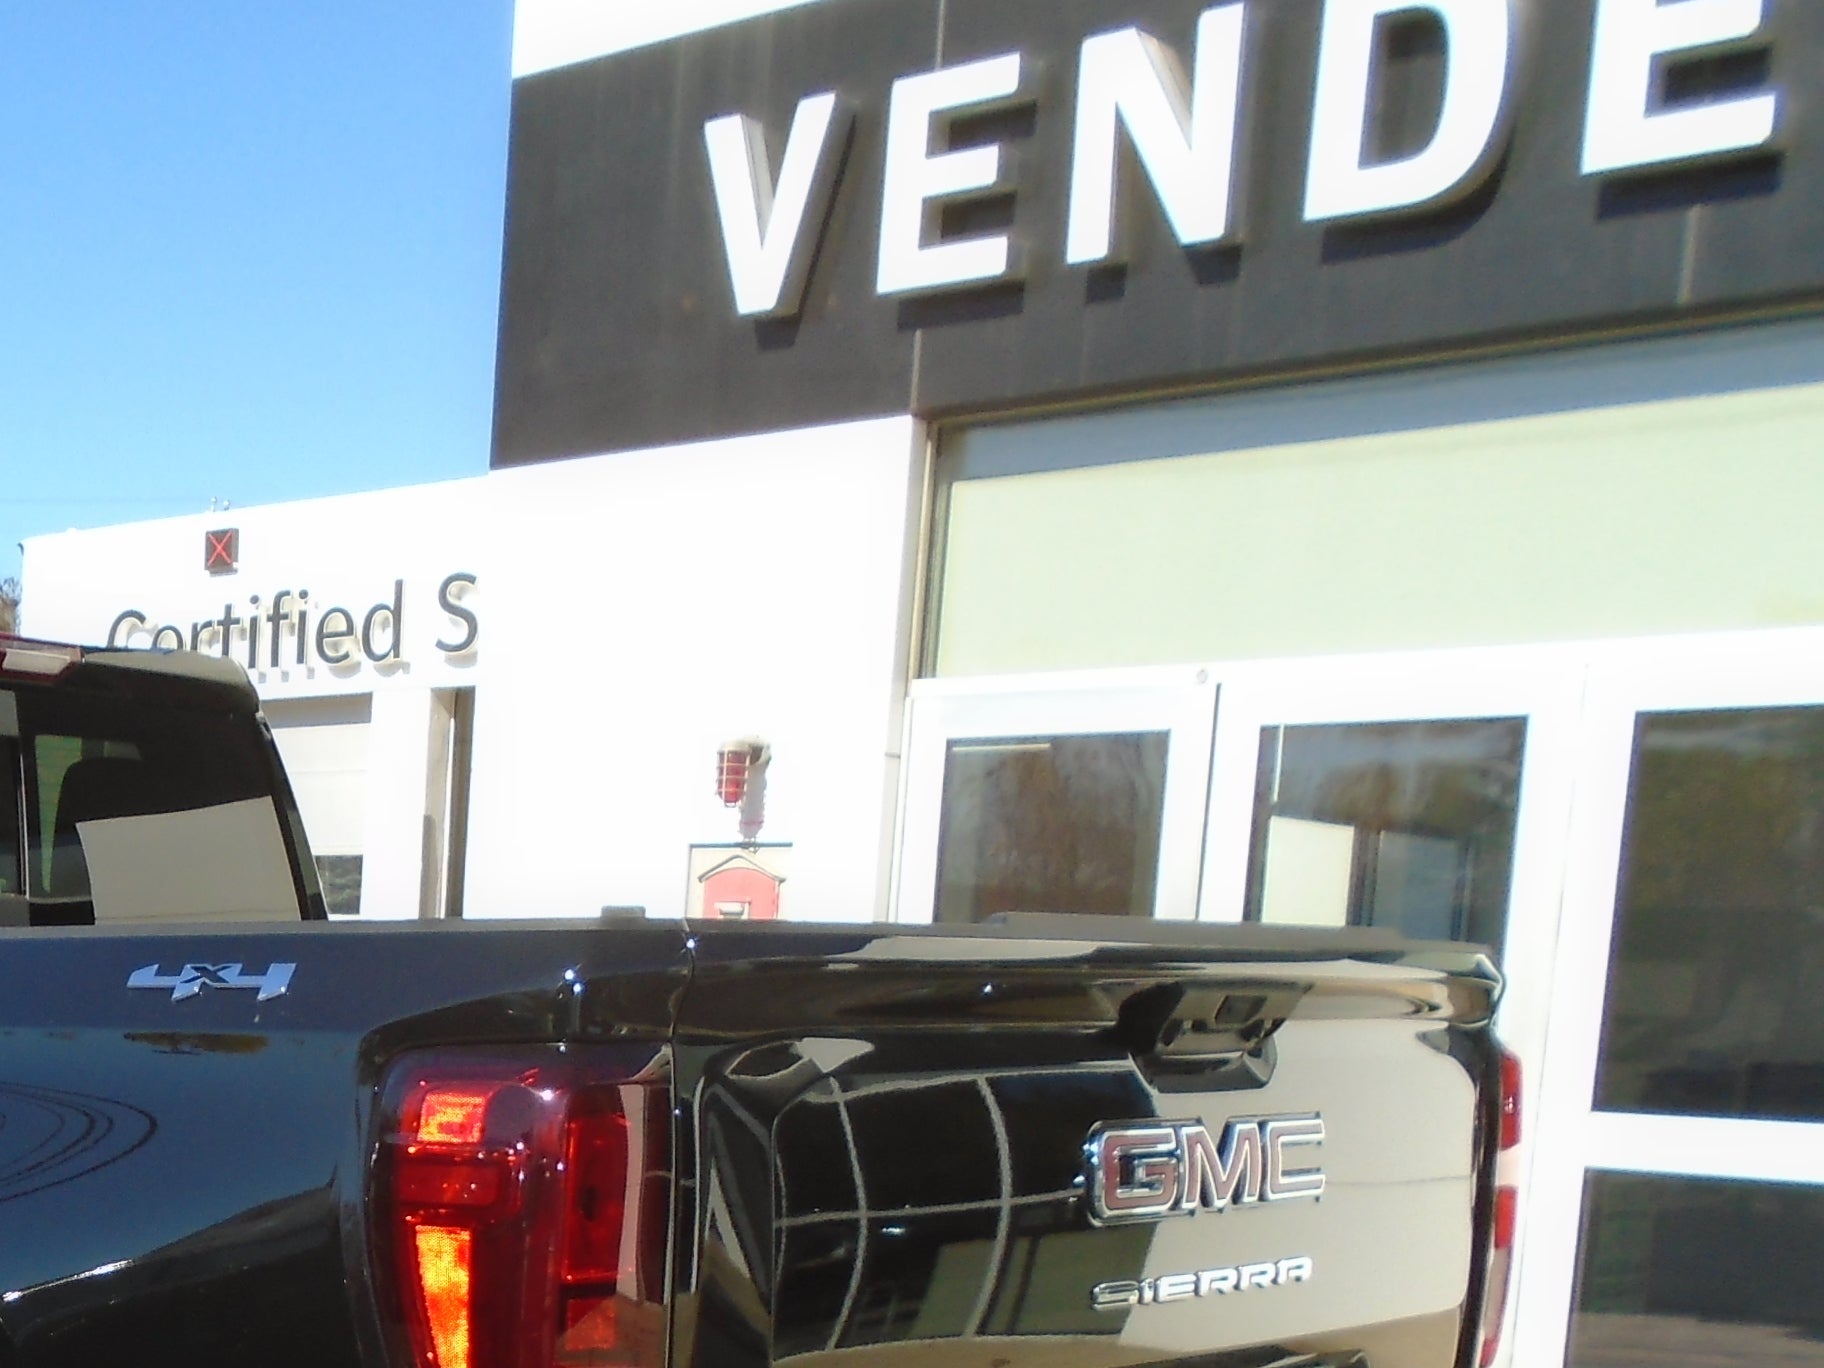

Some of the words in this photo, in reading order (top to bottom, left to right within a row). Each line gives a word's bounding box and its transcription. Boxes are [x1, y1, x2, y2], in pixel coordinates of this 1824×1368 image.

[704, 0, 1777, 318] VENDE
[1083, 1111, 1326, 1227] GMC
[1091, 1255, 1314, 1311] SIERRA
